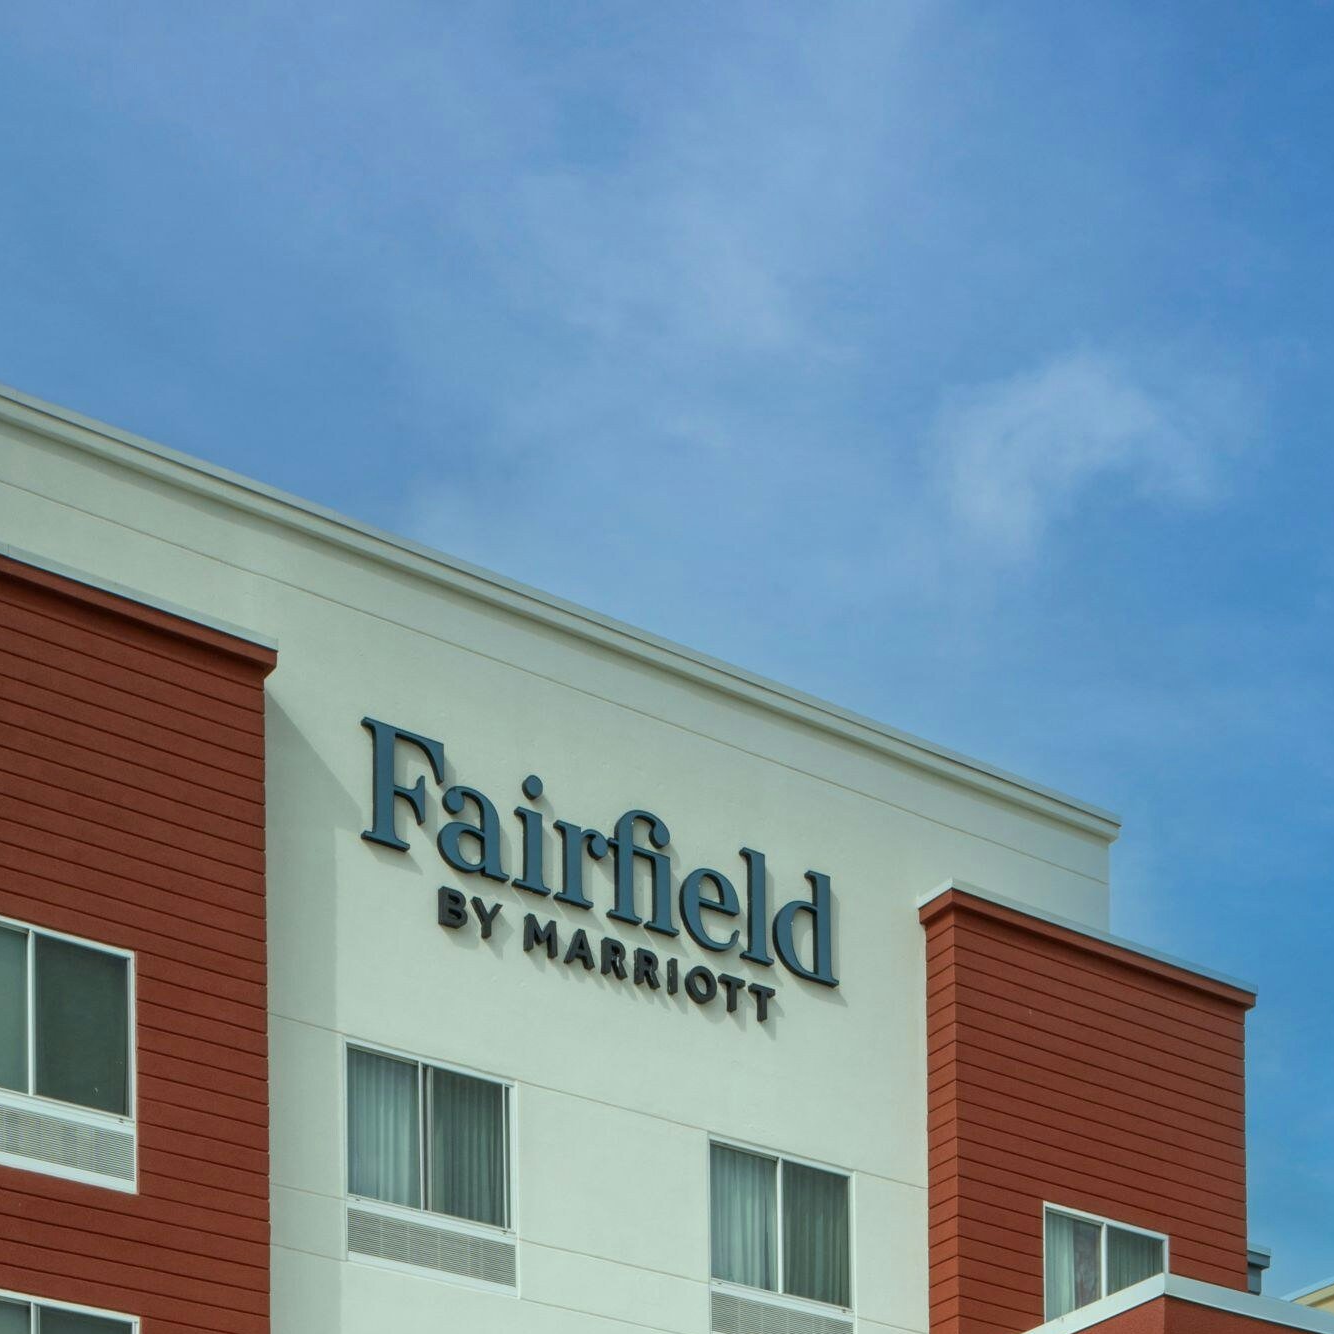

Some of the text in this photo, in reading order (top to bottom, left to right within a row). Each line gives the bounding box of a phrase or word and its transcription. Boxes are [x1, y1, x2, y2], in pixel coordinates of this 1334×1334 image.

[361, 716, 839, 987] Fairfield
[438, 886, 775, 1022] BY MARRIOTT
